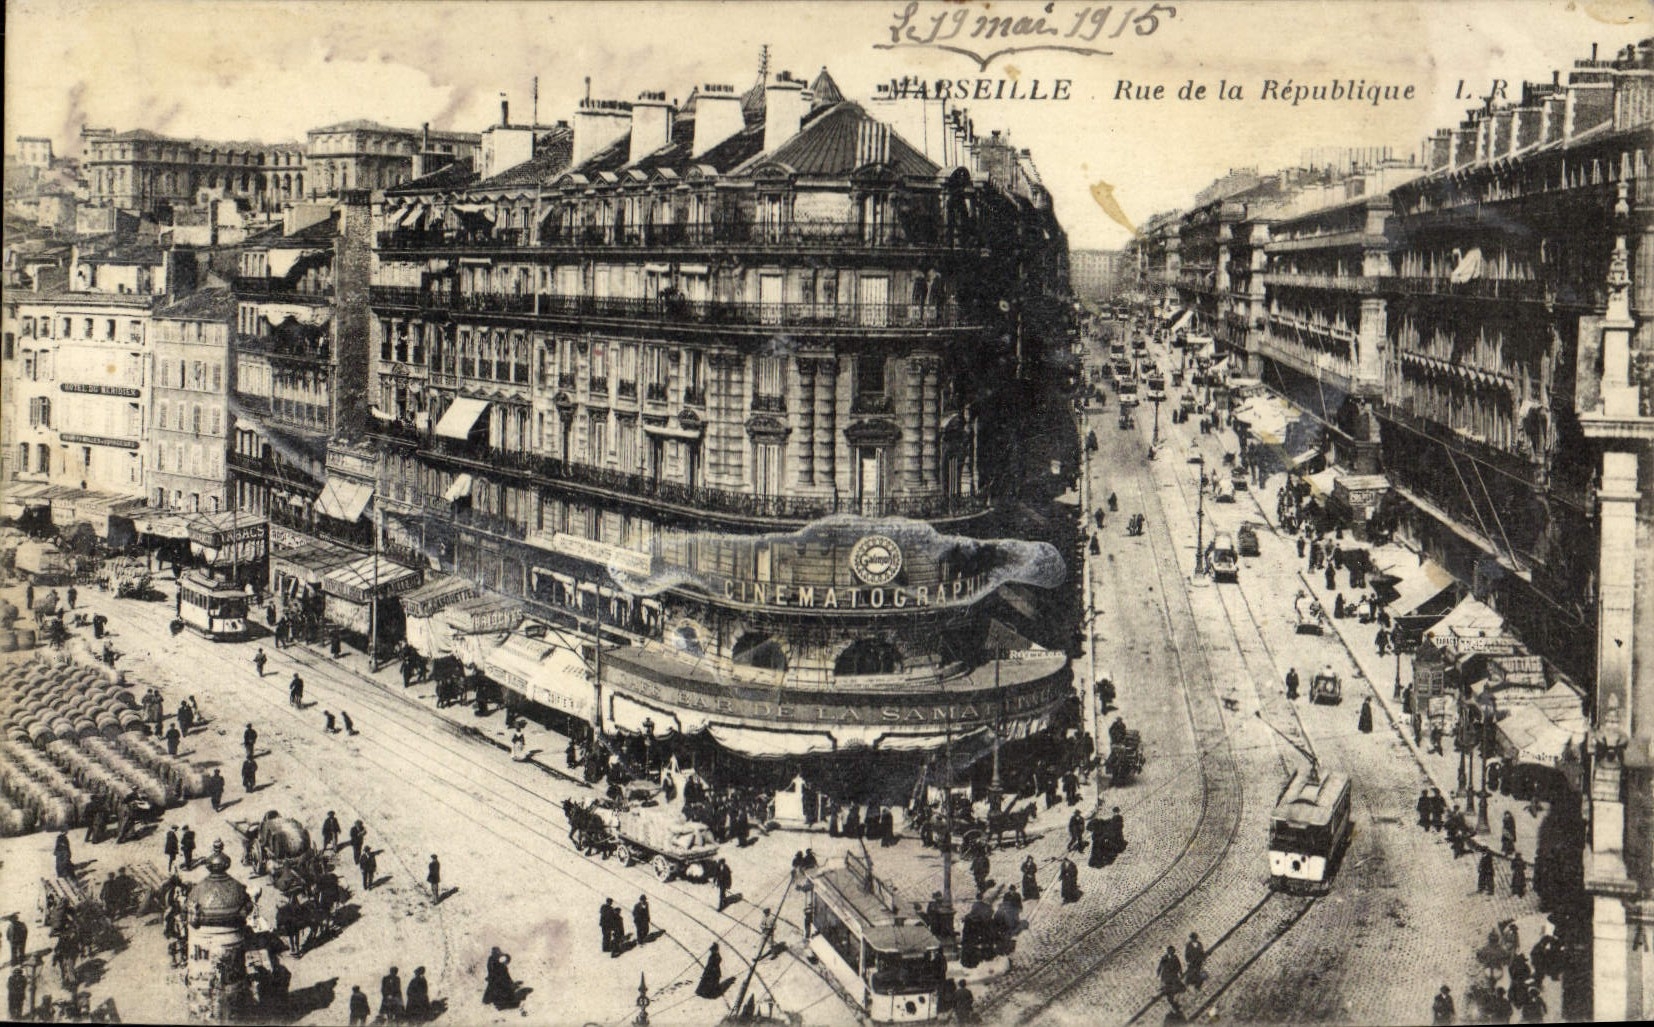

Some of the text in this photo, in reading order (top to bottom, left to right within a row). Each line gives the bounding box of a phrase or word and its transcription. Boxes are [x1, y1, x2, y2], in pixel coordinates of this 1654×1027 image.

[970, 3, 1058, 38] mai
[1064, 3, 1176, 41] 1915
[220, 526, 265, 545] TABACS
[677, 690, 734, 713] BAR
[754, 702, 795, 717] DE
[817, 707, 861, 720] LA
